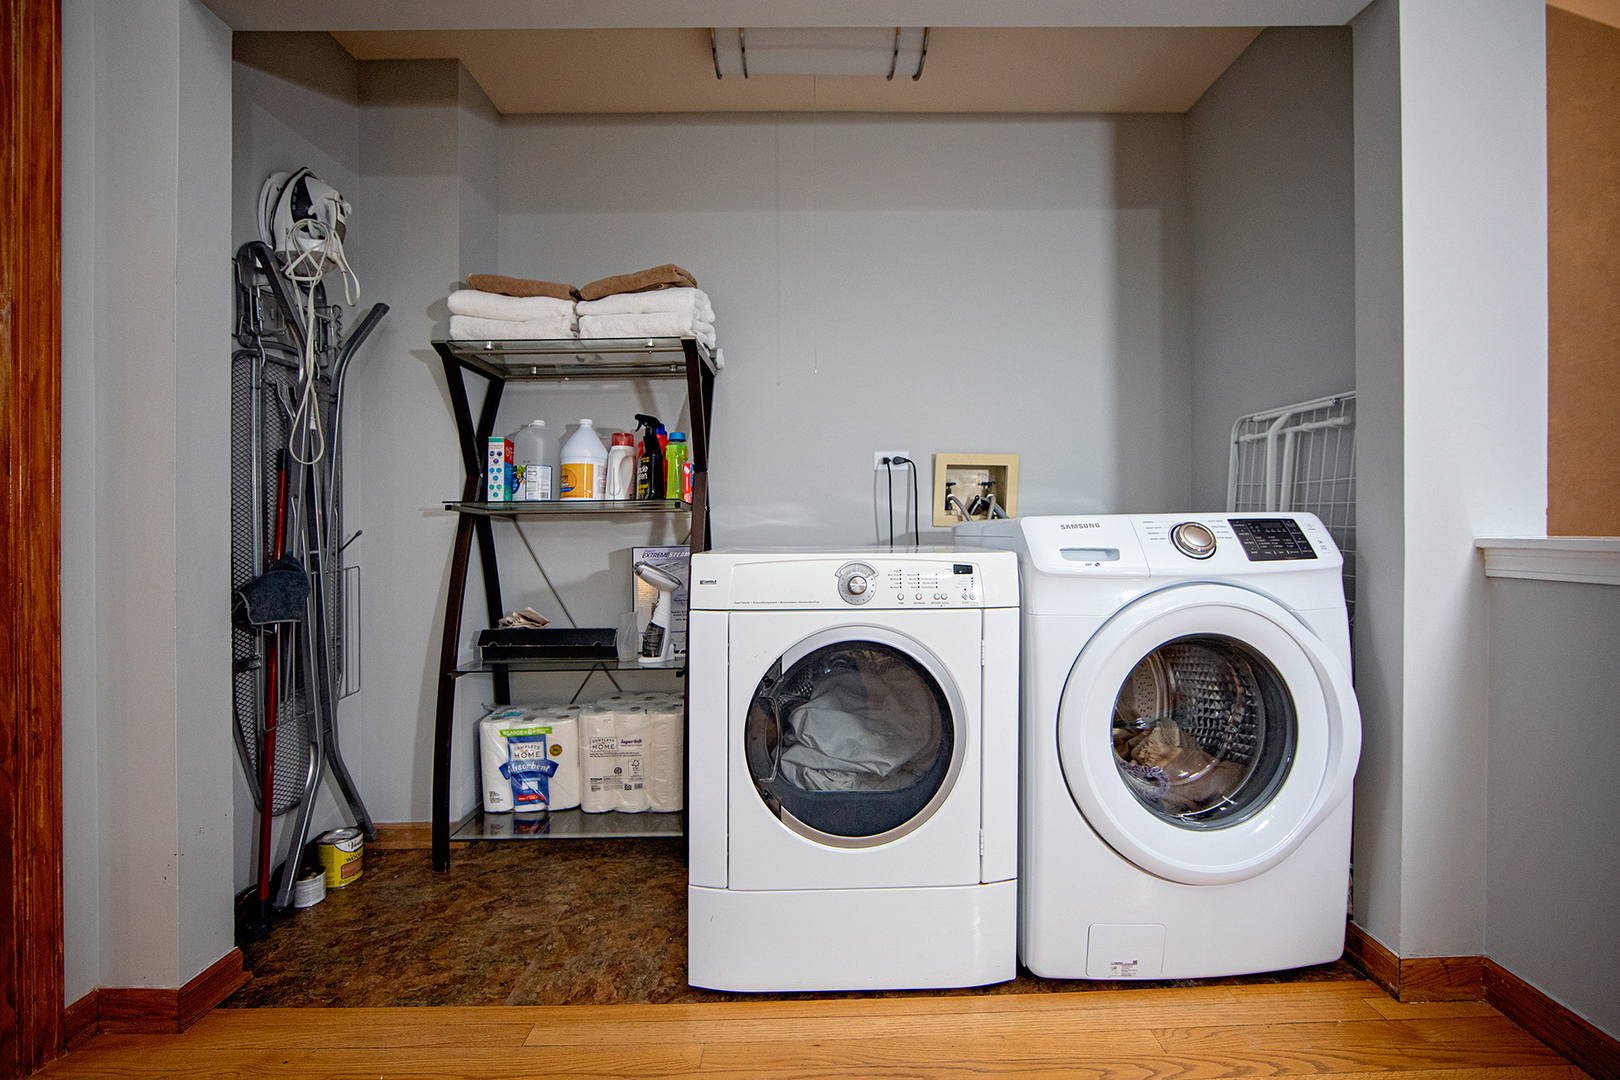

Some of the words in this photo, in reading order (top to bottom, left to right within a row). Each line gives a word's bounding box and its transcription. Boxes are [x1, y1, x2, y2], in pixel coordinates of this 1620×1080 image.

[1060, 522, 1100, 530] SAMSUNG
[513, 744, 541, 752] COMPLETE
[514, 751, 541, 759] HOME
[507, 760, 550, 773] Absorbent
